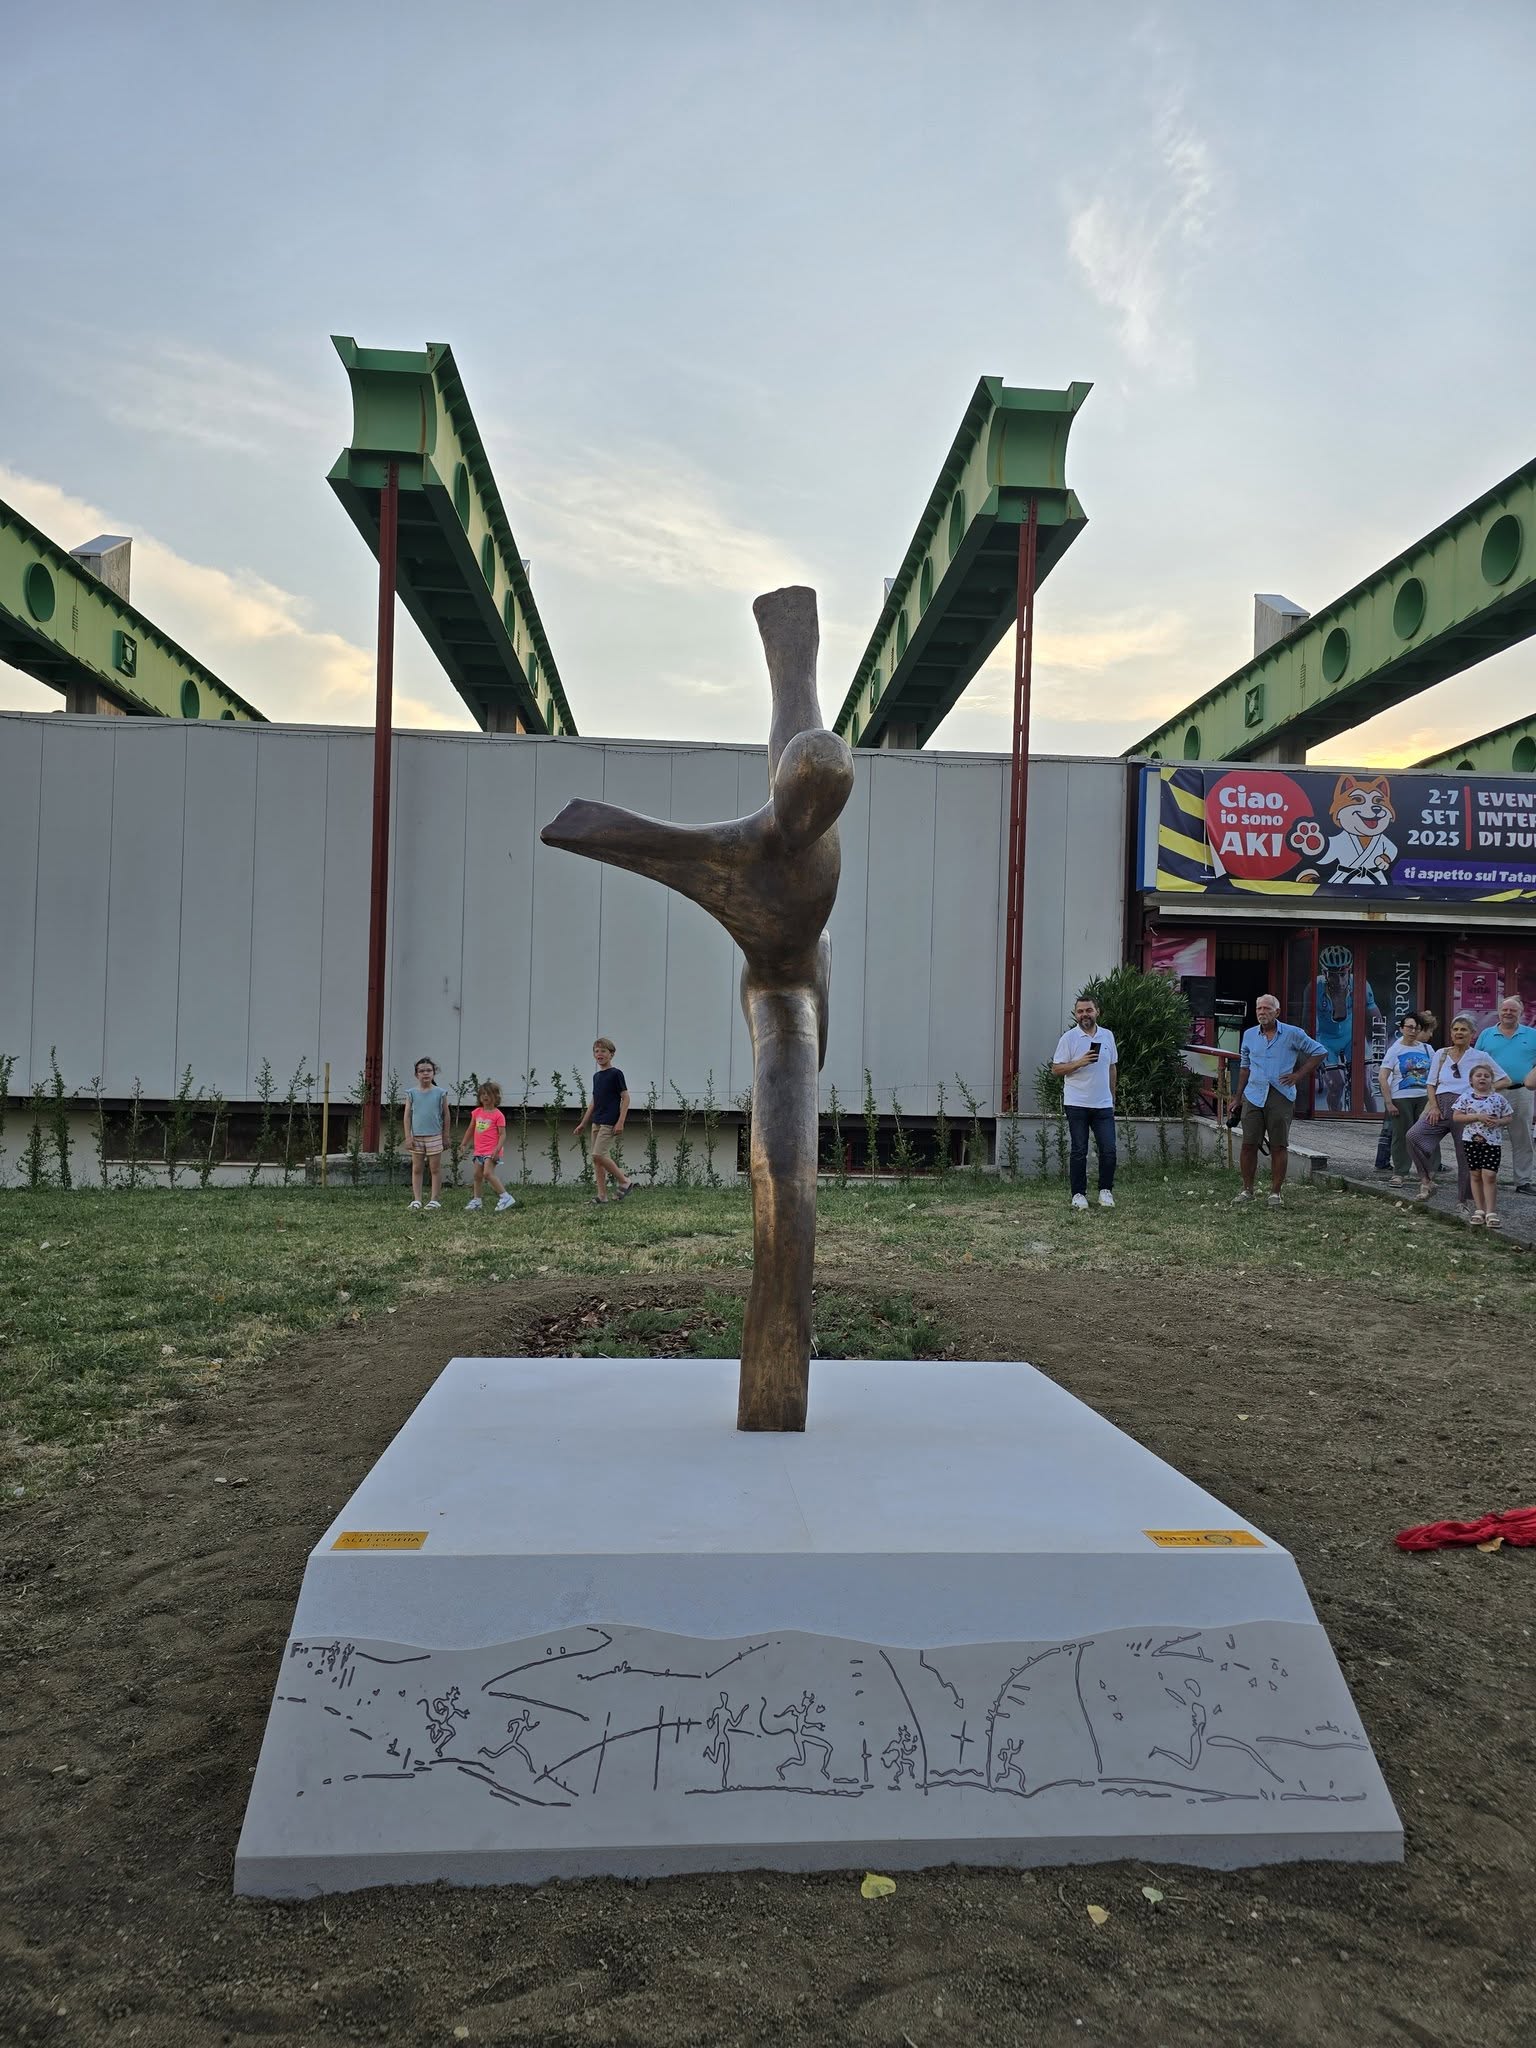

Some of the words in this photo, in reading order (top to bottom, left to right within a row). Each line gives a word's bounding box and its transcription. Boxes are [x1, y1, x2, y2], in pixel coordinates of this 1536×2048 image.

[1219, 785, 1288, 811] Ciao,
[1428, 789, 1459, 805] 2-7
[1477, 792, 1536, 808] EVEN
[1220, 809, 1237, 824] io
[1241, 814, 1284, 826] sono
[1421, 809, 1460, 826] SET
[1219, 831, 1284, 857] AKI
[1407, 830, 1460, 846] 2025
[1478, 831, 1502, 846] DI
[1505, 833, 1536, 848] JU
[1403, 866, 1416, 879] ti
[1417, 869, 1473, 882] aspetto
[1474, 870, 1498, 882] sul
